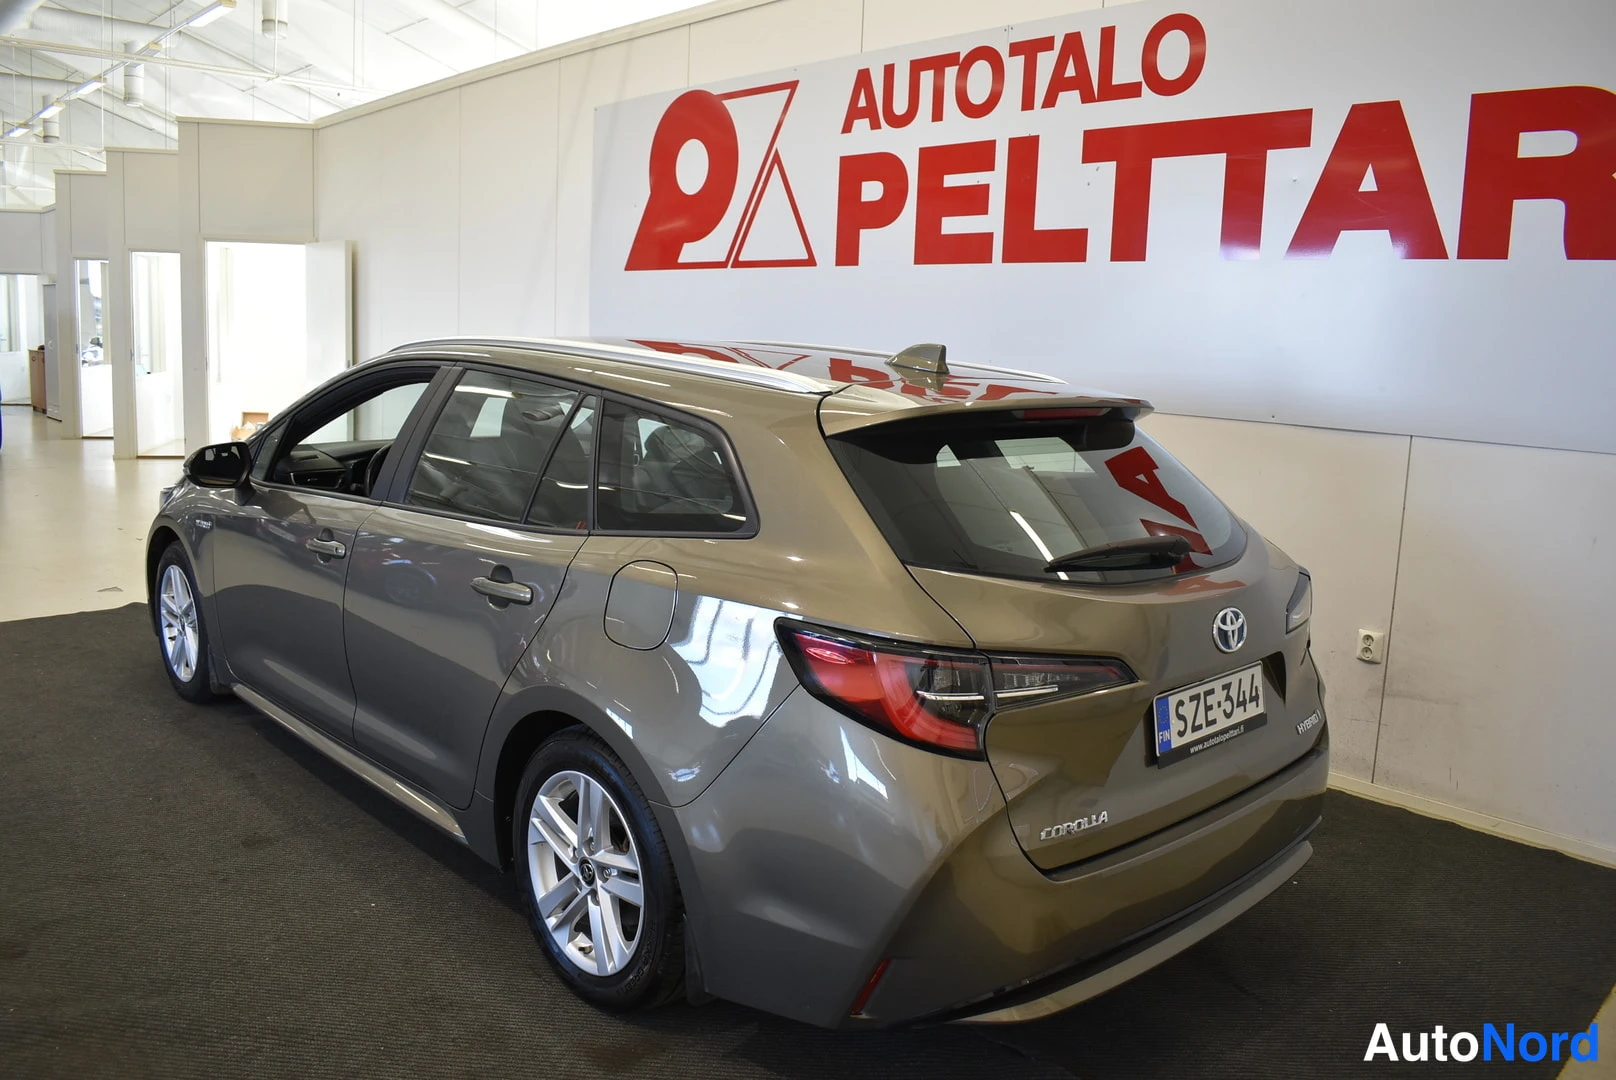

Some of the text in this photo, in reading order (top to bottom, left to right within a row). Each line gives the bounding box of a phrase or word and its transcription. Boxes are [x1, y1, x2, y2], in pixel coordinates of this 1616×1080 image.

[840, 13, 1207, 134] AUTOTALO
[835, 85, 1616, 266] PELTTAR
[1174, 673, 1260, 738] SZE-344
[1158, 729, 1171, 744] FIN
[1189, 724, 1245, 754] www.autotalopelttari.fi
[1040, 810, 1108, 840] COROLLA
